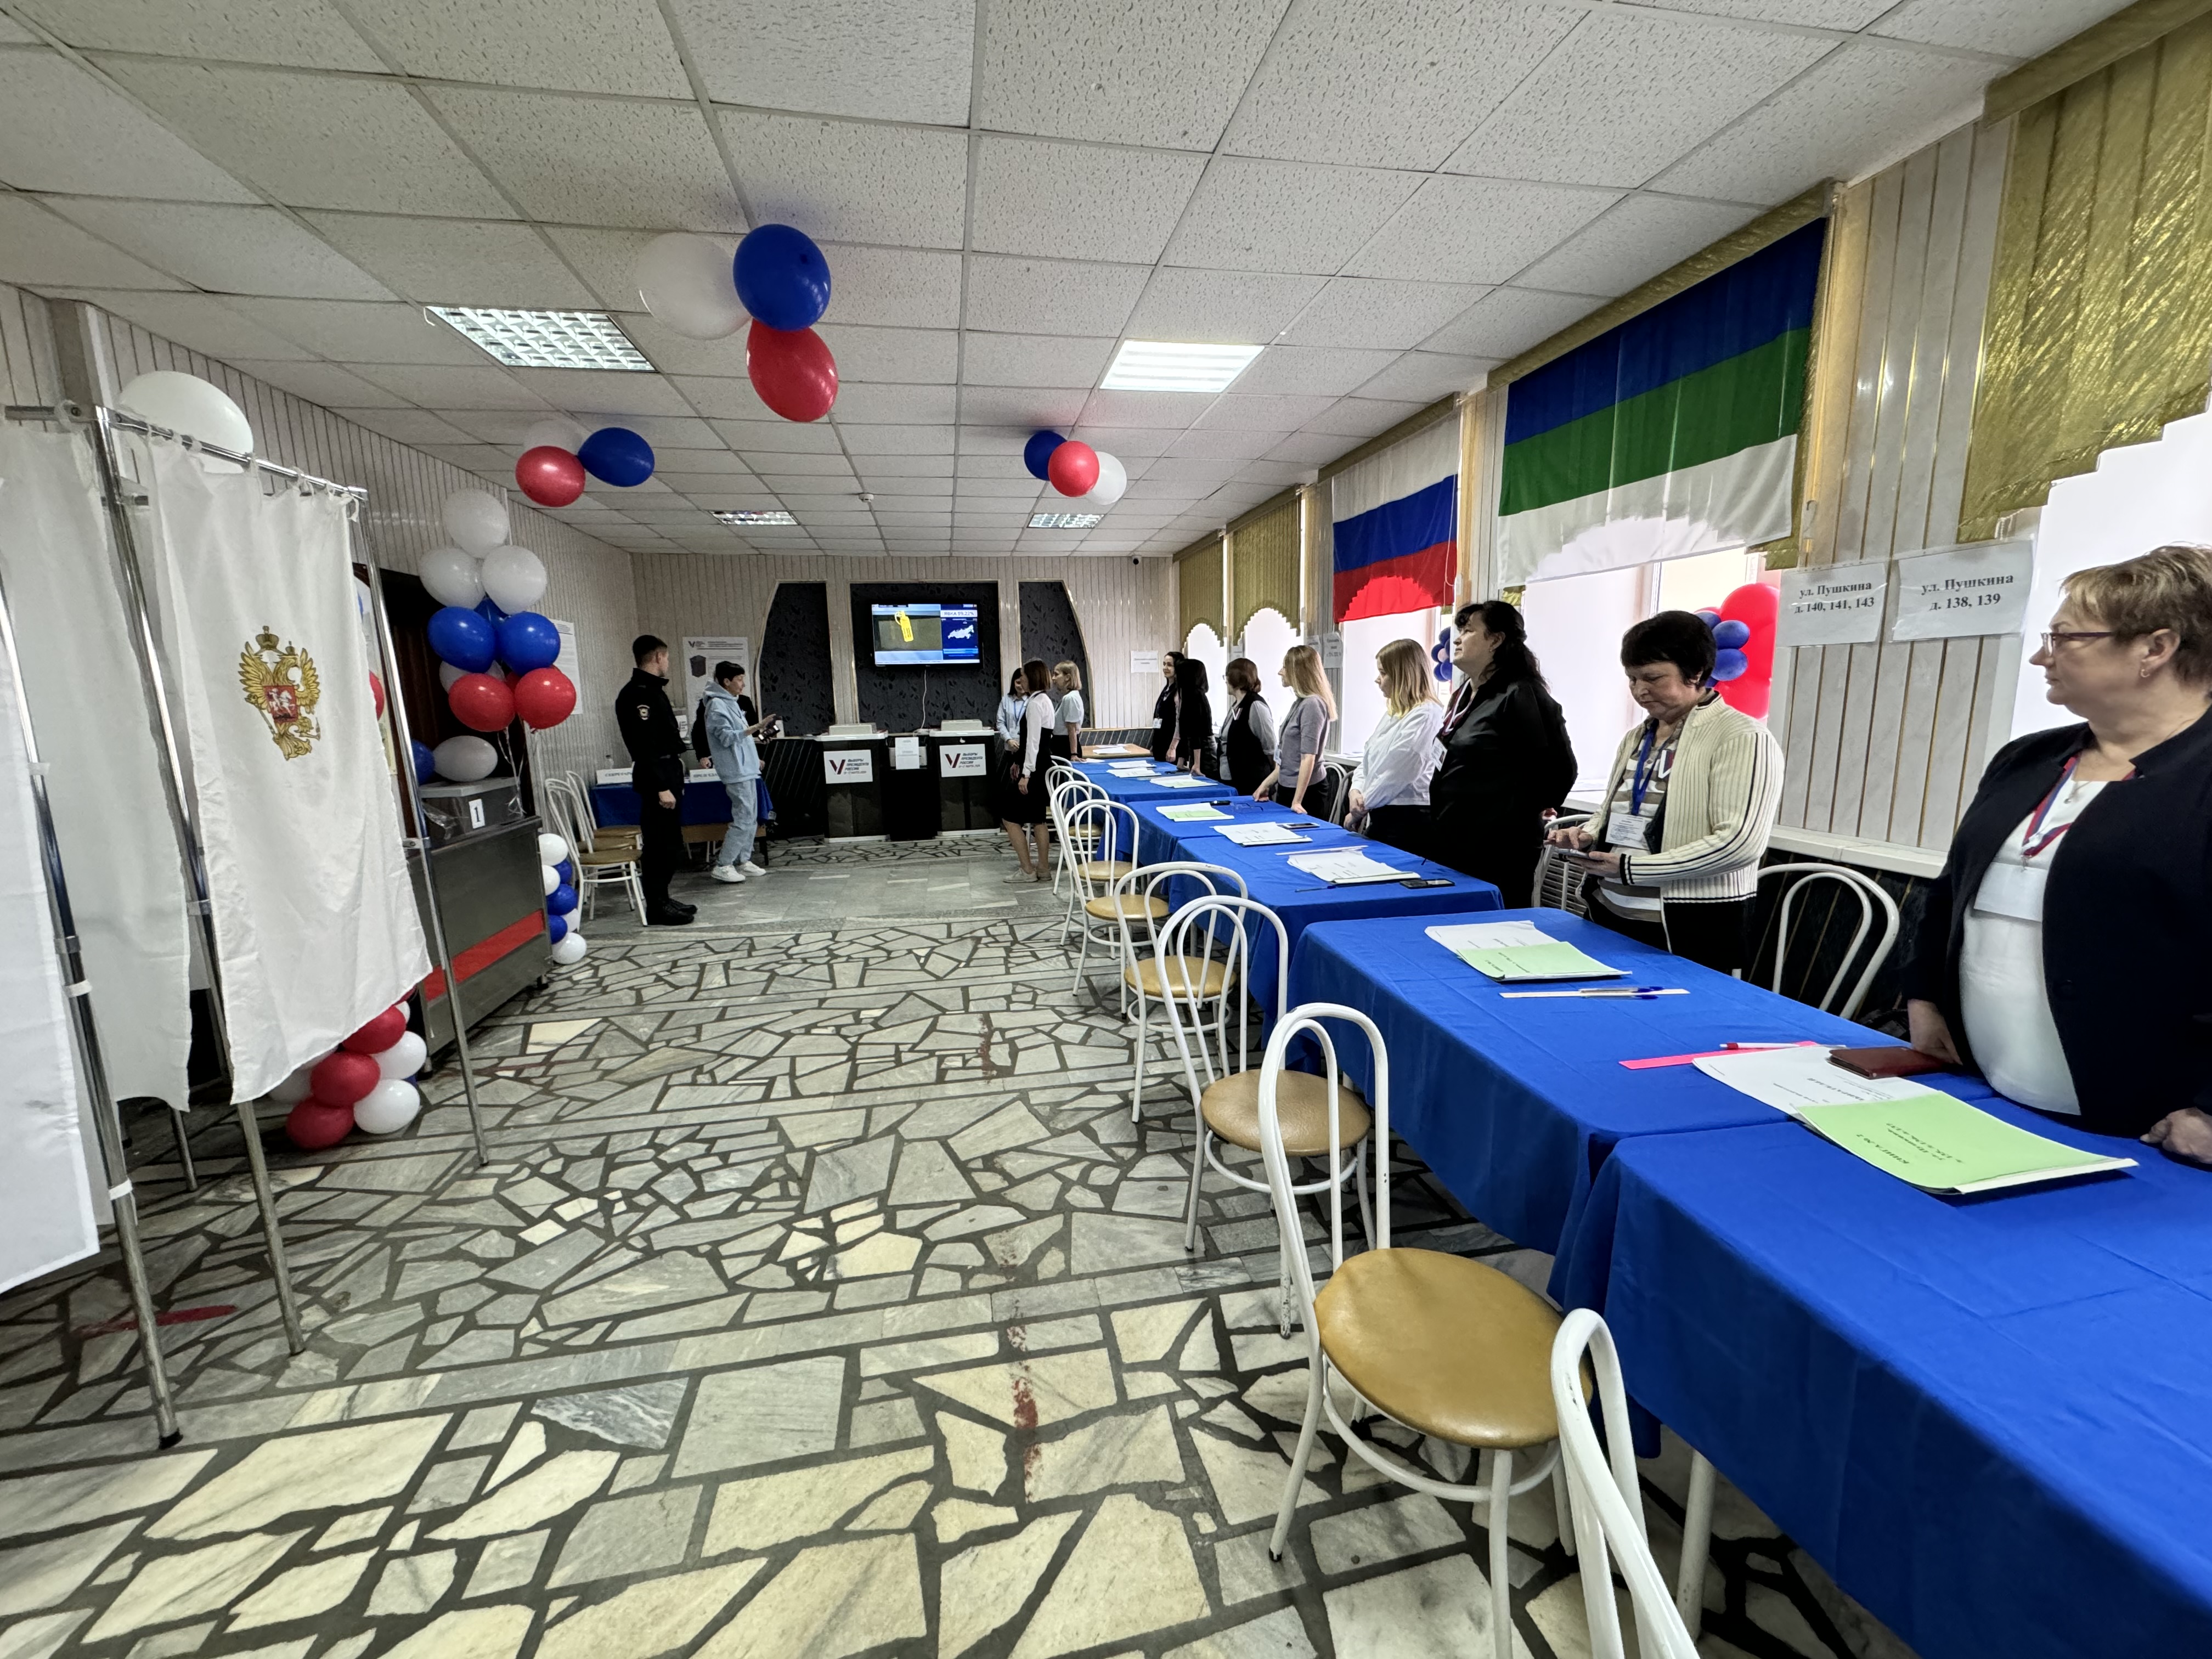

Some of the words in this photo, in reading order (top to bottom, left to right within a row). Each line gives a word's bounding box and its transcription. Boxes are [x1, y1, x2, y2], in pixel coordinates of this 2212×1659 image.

[1799, 589, 1814, 599] ул.
[1817, 583, 1872, 596] Пушкина
[1921, 584, 1939, 595] ул.
[1944, 575, 2013, 592] Пушкина
[1807, 602, 1826, 612] 140,
[1830, 600, 1852, 610] 141,
[1855, 597, 1874, 608] 143
[1928, 602, 1942, 611] д.
[1946, 596, 1972, 610] 138,
[1977, 593, 2001, 606] 139
[474, 806, 481, 822] 1
